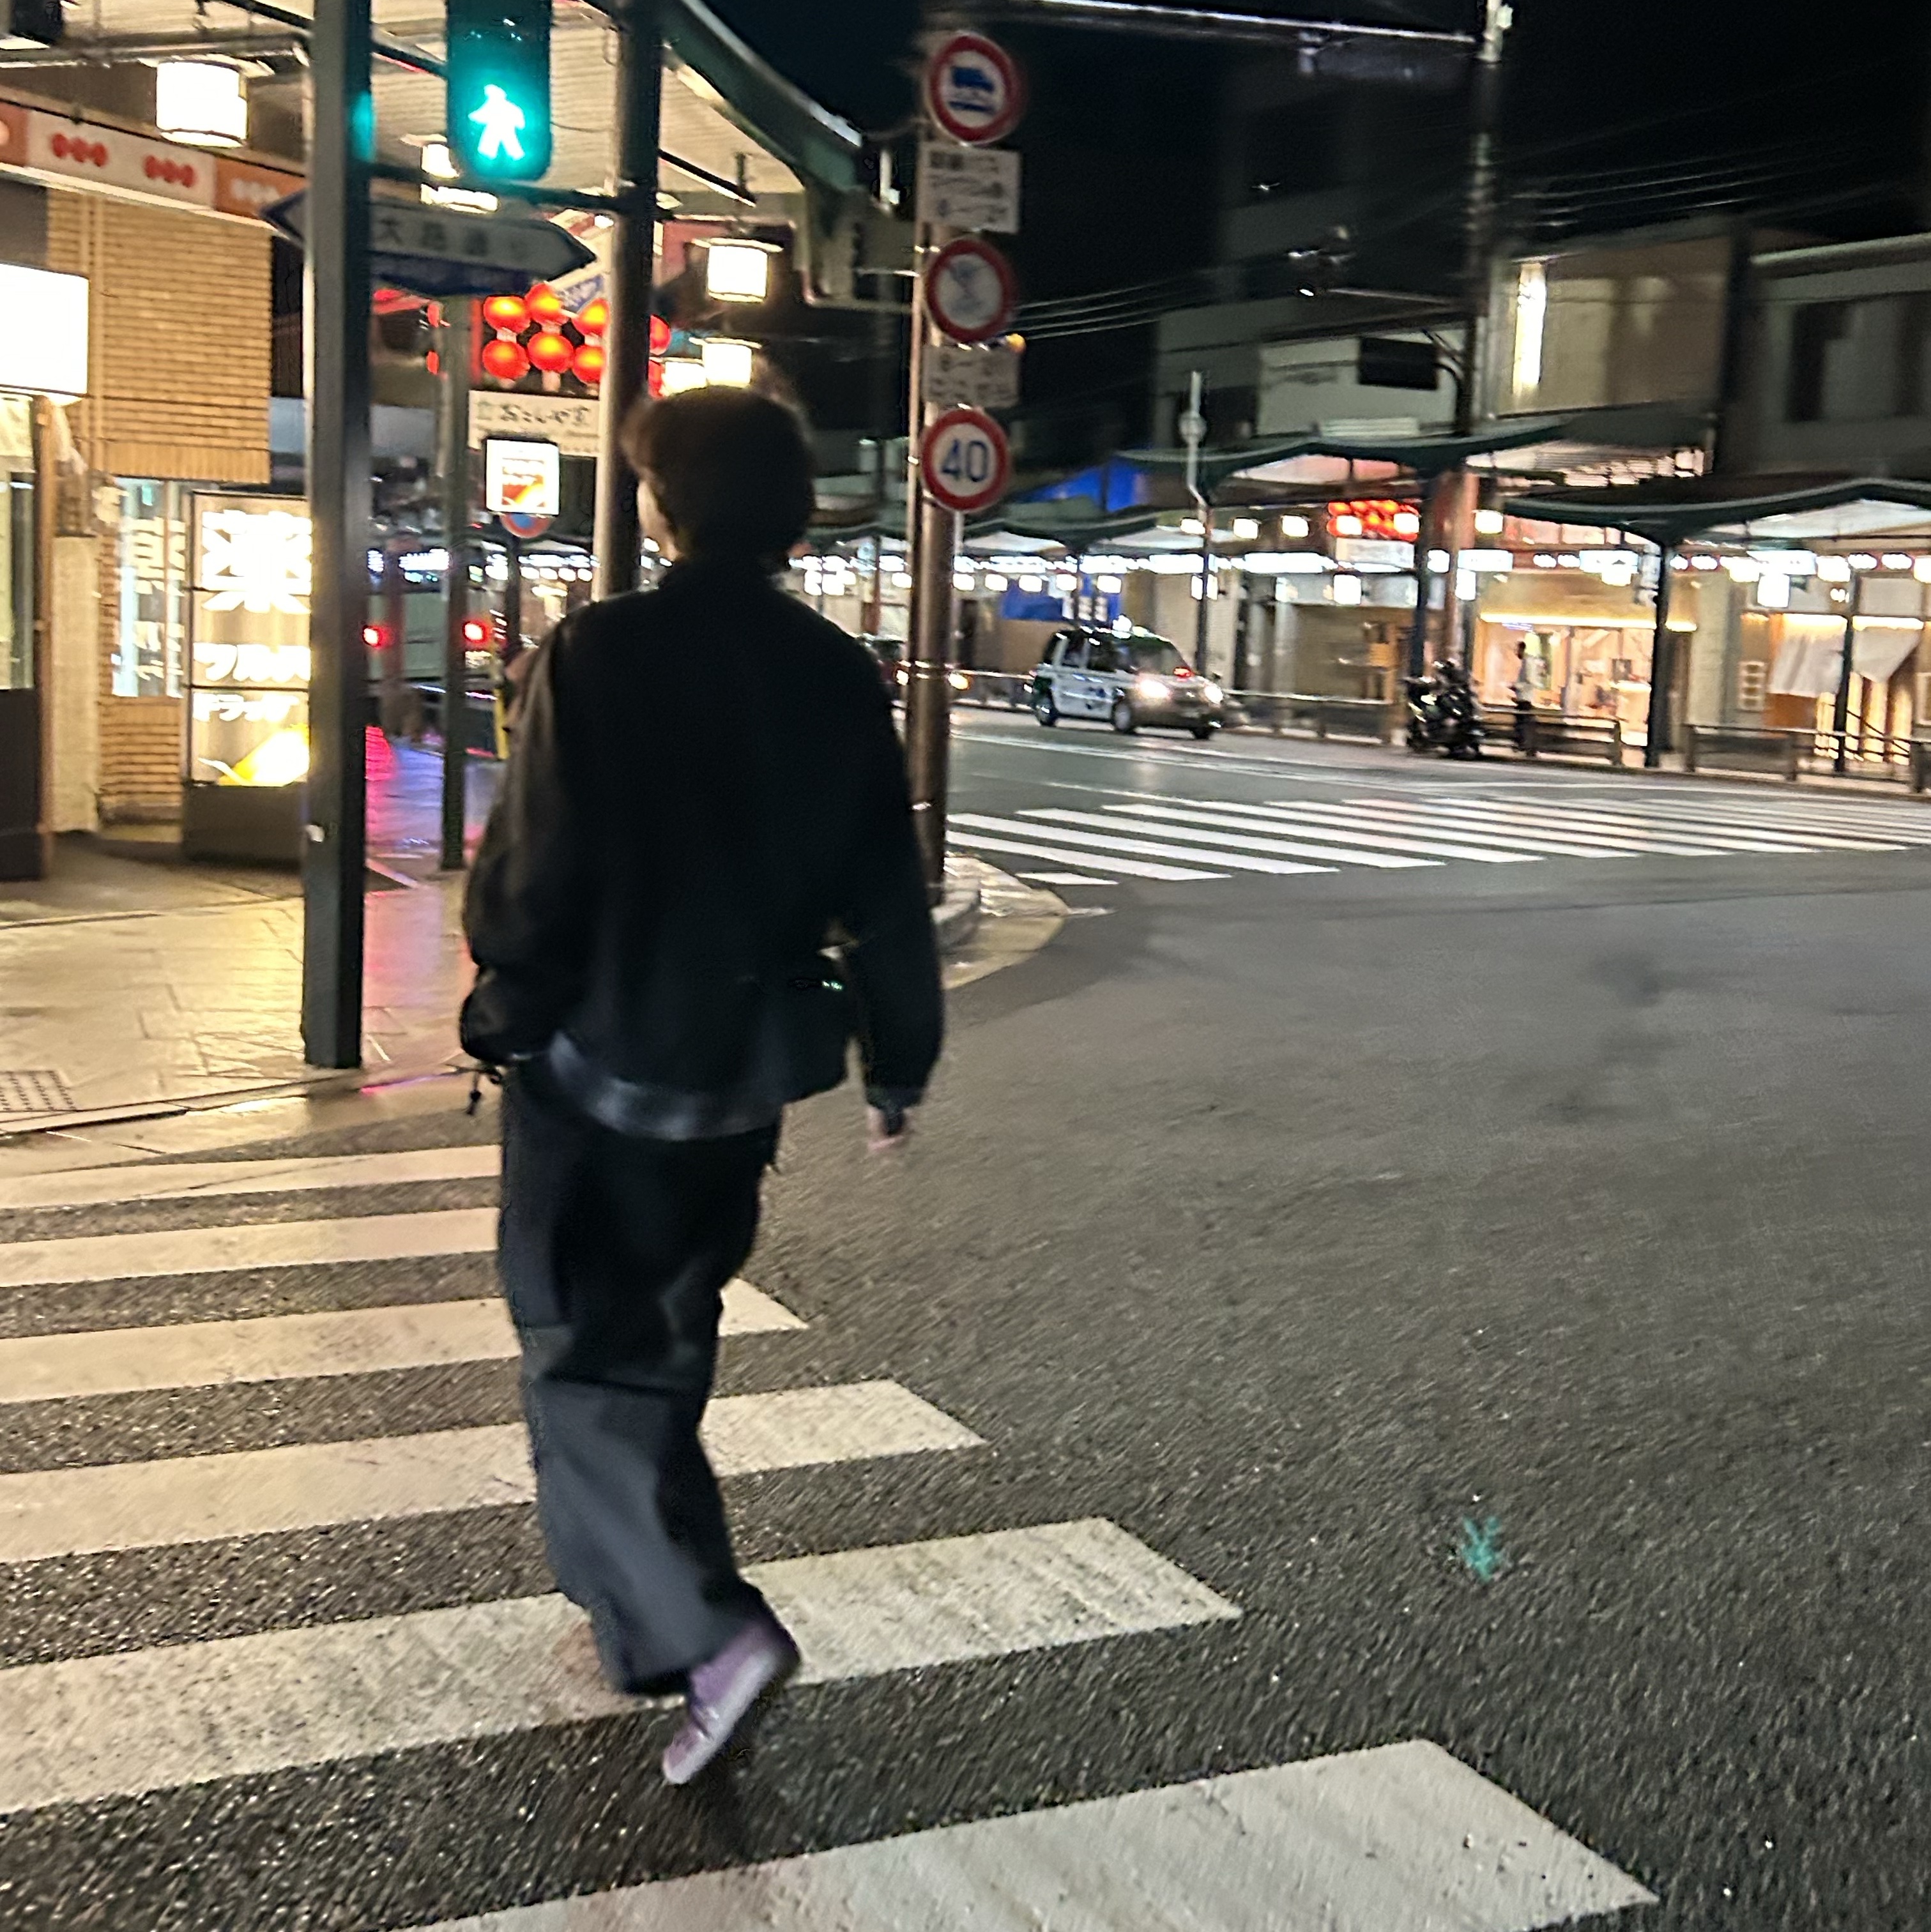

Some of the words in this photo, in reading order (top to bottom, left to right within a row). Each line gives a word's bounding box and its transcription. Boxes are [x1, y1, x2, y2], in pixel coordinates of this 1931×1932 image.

[942, 439, 988, 482] 40
[201, 509, 312, 614] 薬
[193, 692, 300, 722] ドラッグ
